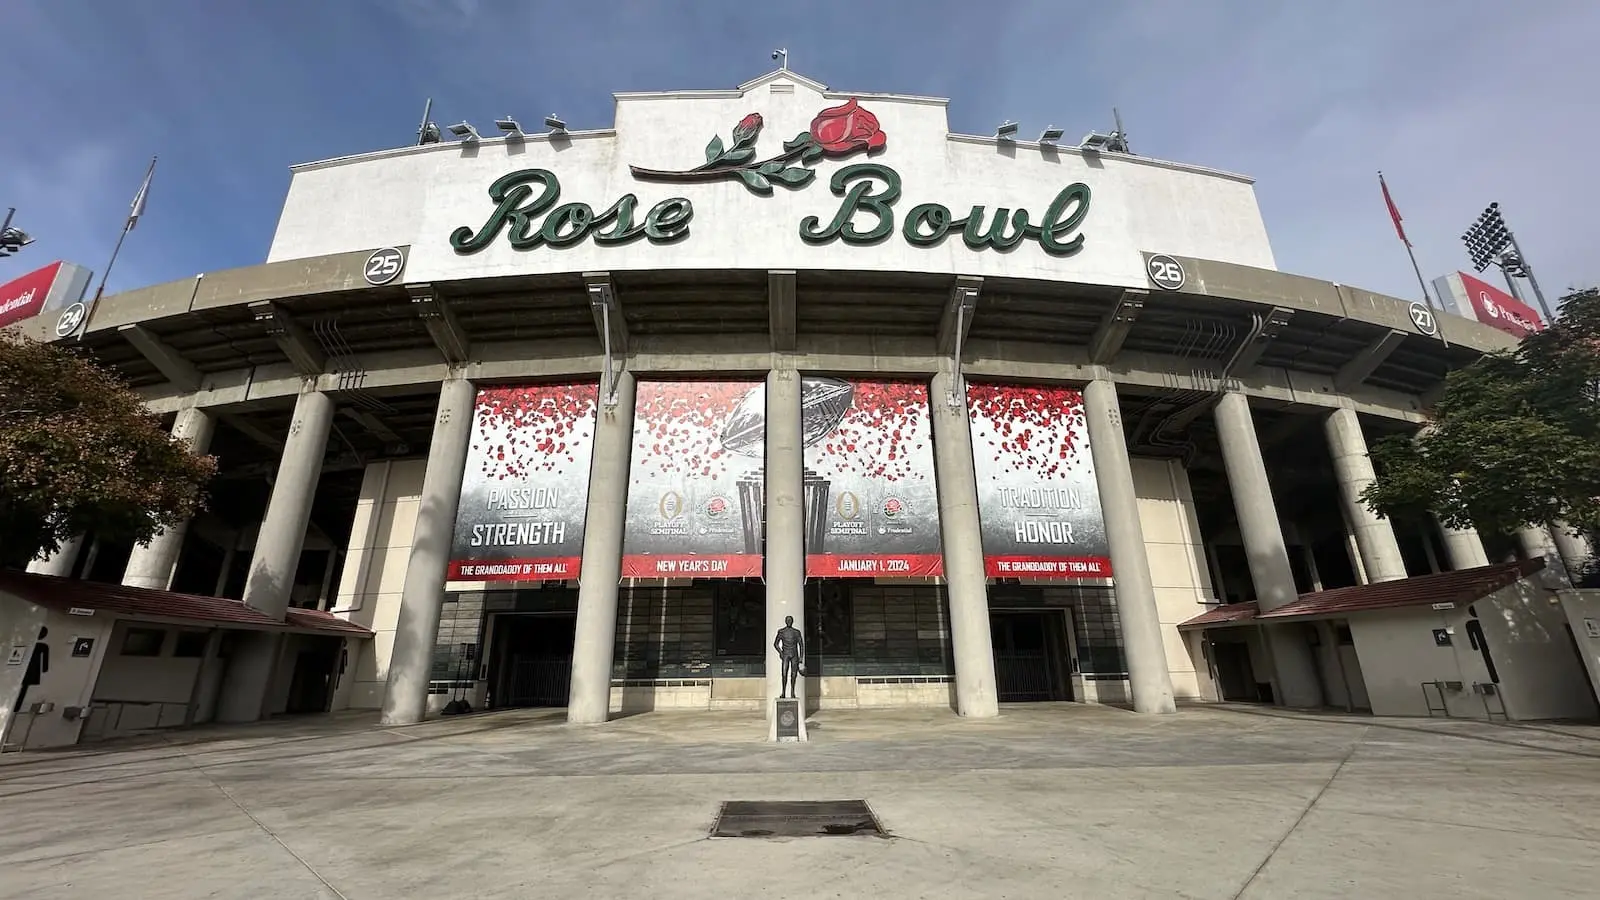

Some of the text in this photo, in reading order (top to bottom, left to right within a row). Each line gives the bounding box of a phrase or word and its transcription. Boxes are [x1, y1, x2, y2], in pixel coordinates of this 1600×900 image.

[450, 163, 1092, 257] Rose Bowl
[366, 254, 400, 276] 25
[1151, 261, 1182, 282] 26
[59, 309, 81, 330] 24
[1412, 308, 1431, 327] 27
[487, 487, 560, 511] PASSION
[999, 487, 1082, 509] TRADITION
[470, 521, 566, 547] STRENGTH
[830, 527, 867, 535] SEMIFINAL
[1014, 521, 1075, 544] HONOR
[461, 563, 567, 575] THE GRANDDADDY OF THEM ALL
[656, 560, 728, 572] NEW YEAR'S DAY
[838, 560, 910, 573] JANUARY 1, 2024
[997, 561, 1101, 572] THE GRANDDADDY OF THEM ALL
